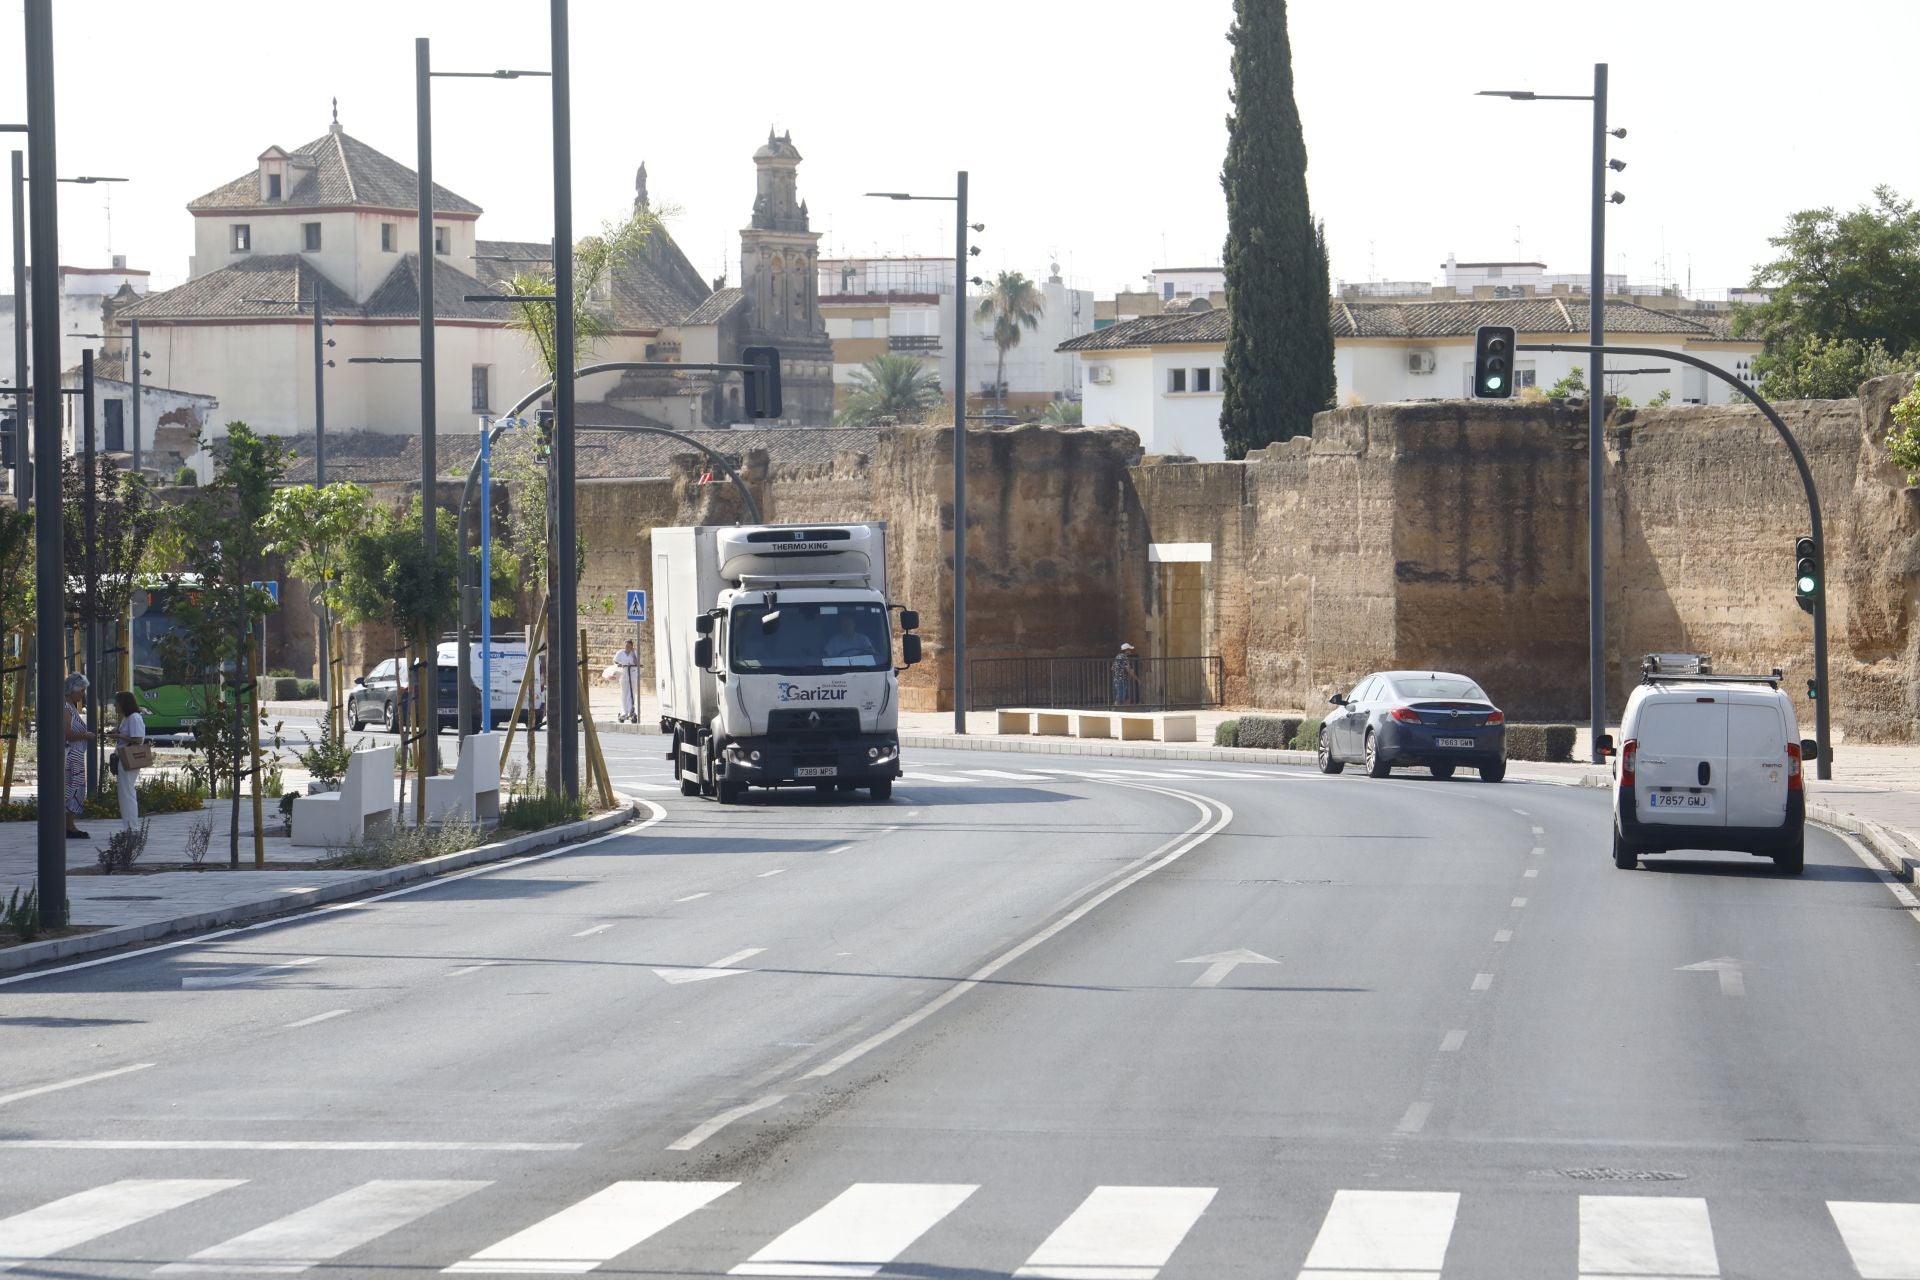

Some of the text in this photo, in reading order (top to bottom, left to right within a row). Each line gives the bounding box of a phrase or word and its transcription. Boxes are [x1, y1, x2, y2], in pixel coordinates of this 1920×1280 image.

[772, 542, 828, 551] THERMO KING
[785, 684, 848, 701] Garizur
[799, 768, 818, 776] 7389
[1659, 795, 1706, 807] 7857 GMJ
